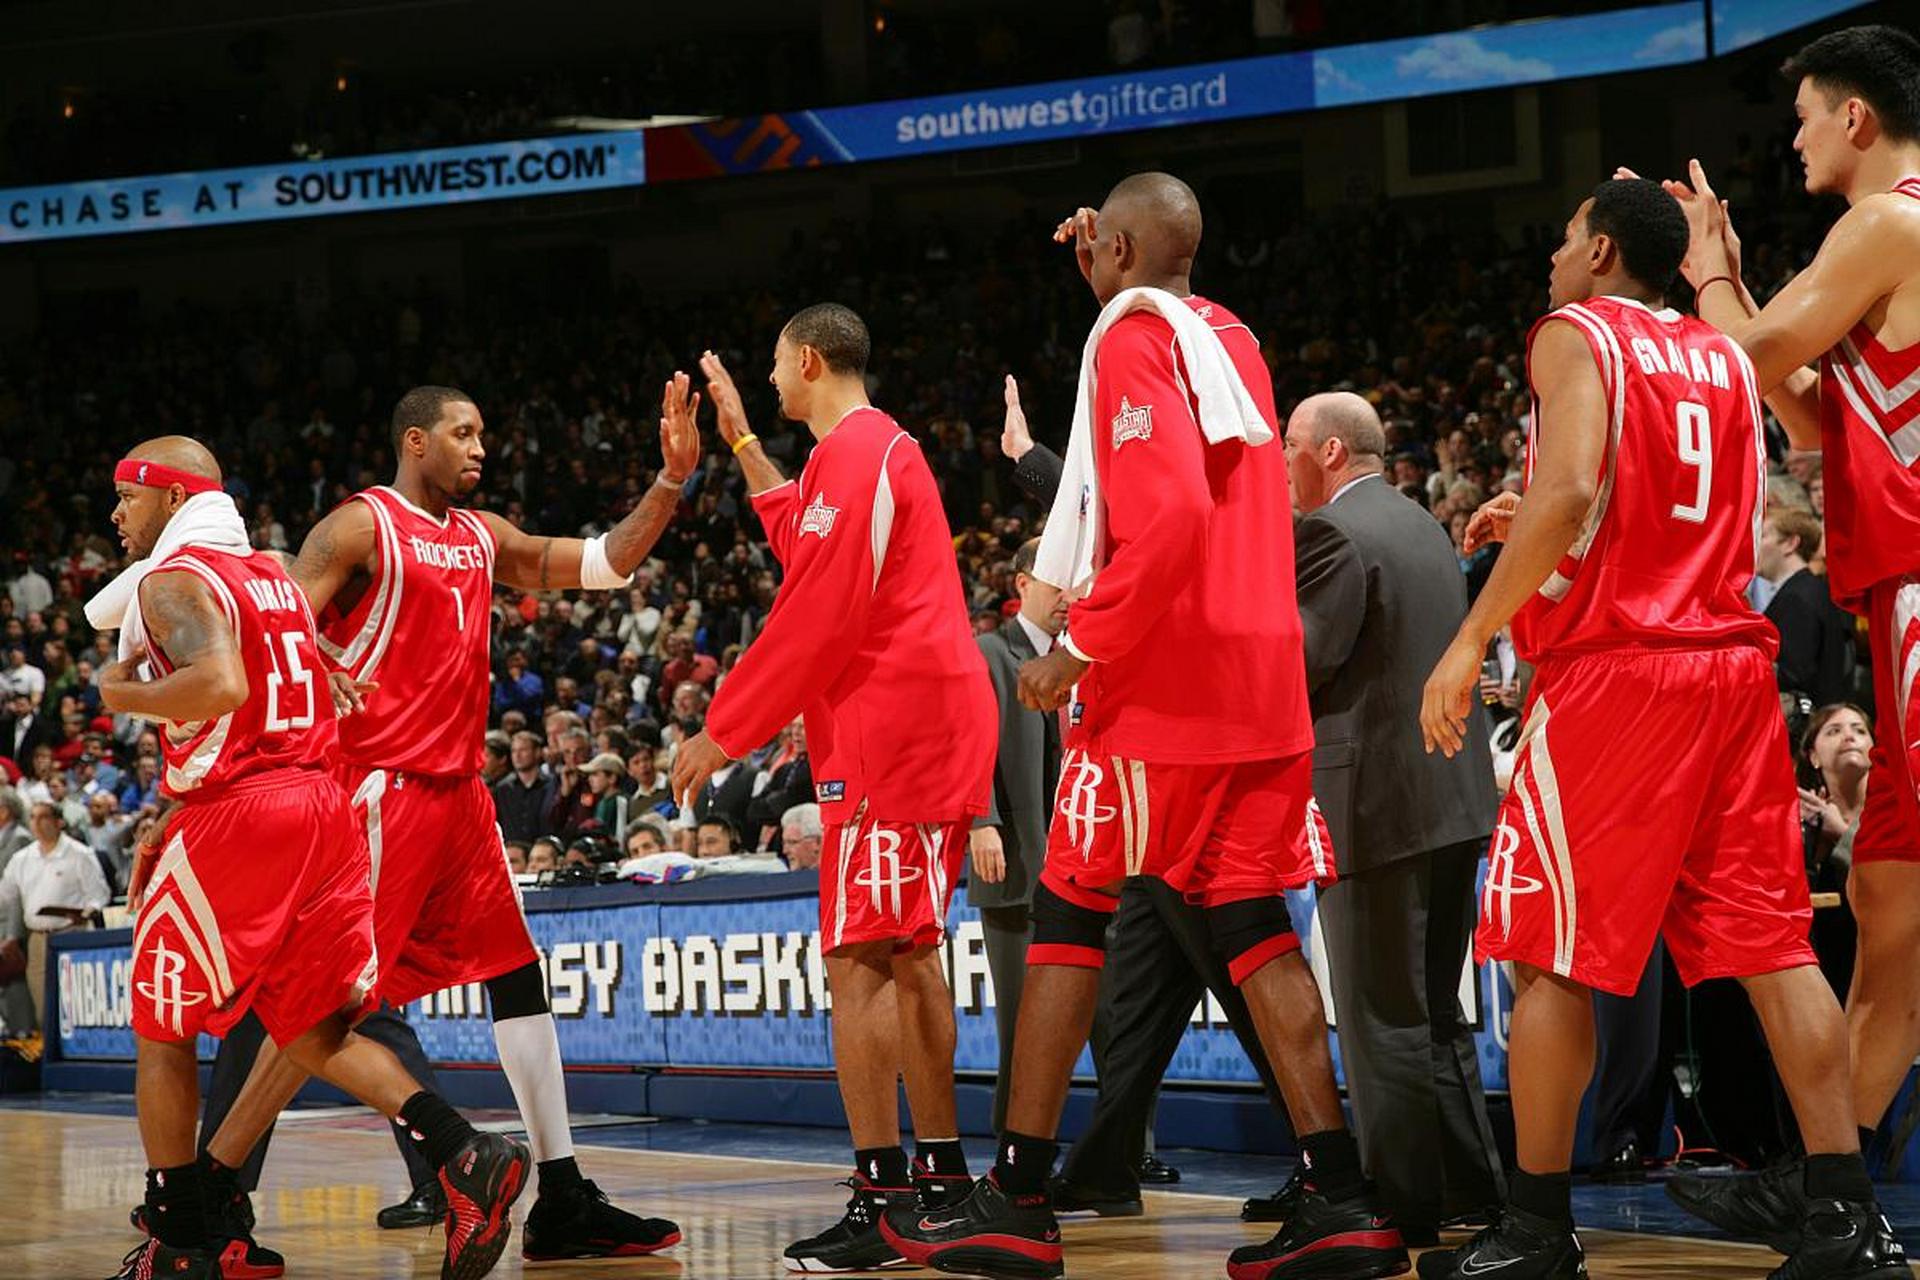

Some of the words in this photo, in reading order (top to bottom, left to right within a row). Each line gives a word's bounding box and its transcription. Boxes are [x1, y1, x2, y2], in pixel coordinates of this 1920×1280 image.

[9, 189, 161, 228] CHASE
[194, 180, 243, 213] AT
[275, 145, 613, 206] SOUTHWEST.COM
[1630, 336, 1731, 390] GRAAM
[1671, 400, 1713, 525] 9
[408, 534, 484, 570] ROCKETS
[450, 586, 465, 632] 1
